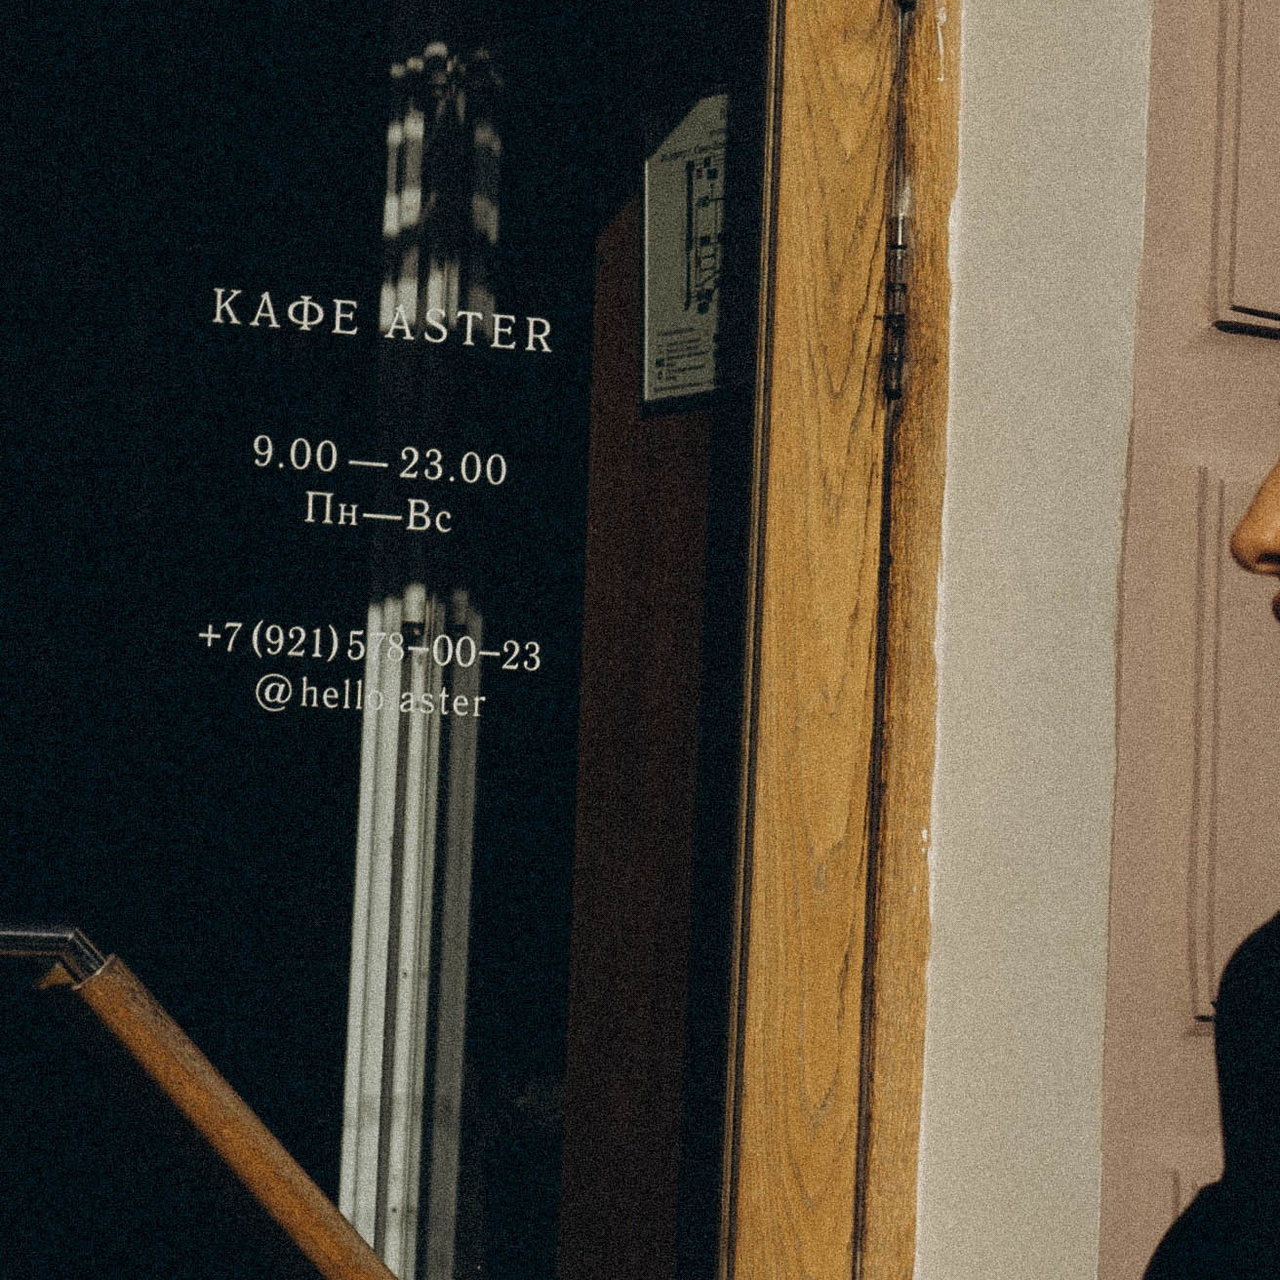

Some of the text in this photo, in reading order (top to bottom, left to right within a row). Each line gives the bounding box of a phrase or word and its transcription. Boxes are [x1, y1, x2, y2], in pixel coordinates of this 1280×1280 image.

[212, 287, 553, 353] КАФЕ ASTER
[253, 434, 338, 472] 9.00
[399, 446, 507, 486] 23.00
